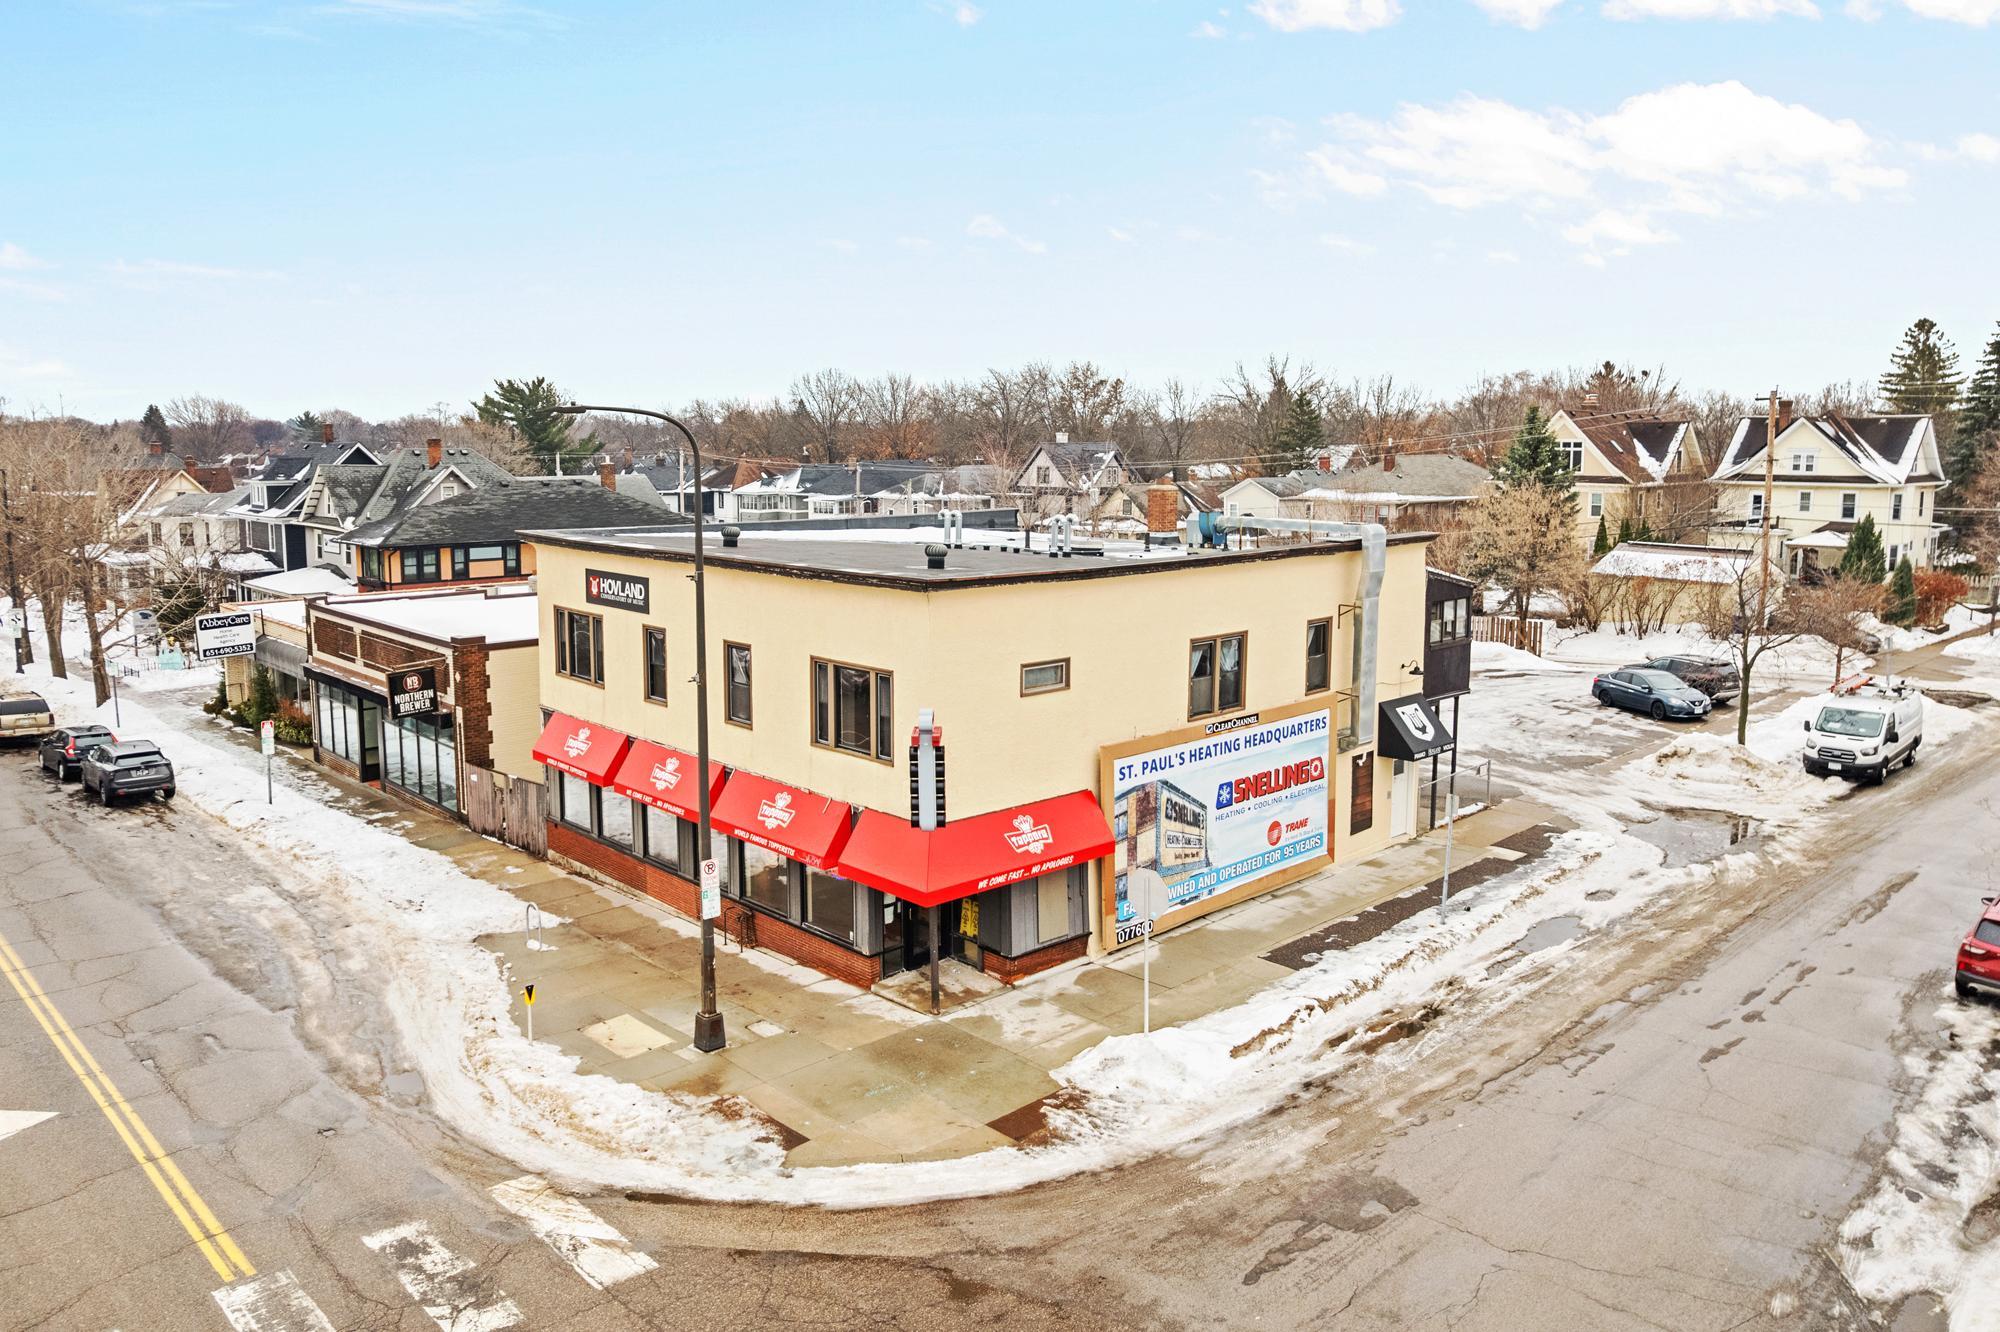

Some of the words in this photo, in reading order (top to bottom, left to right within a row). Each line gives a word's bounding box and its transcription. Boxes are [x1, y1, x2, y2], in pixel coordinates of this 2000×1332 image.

[600, 578, 645, 600] HOVLAND
[201, 615, 250, 629] AbbeyCare
[205, 644, 252, 657] 651-690-5352
[394, 688, 434, 705] NORTHERN
[399, 698, 431, 713] BREWER
[1118, 764, 1138, 781] ST.
[1141, 751, 1186, 776] PAUL'S
[1189, 737, 1241, 763] HEATING
[1244, 716, 1327, 749] HEADQUARTERS
[1234, 759, 1310, 804] SNELLING
[1215, 807, 1246, 822] HEATING
[1253, 795, 1283, 810] COOLING
[1290, 783, 1325, 799] ELECTRICAL
[1285, 817, 1309, 834] TRANE
[734, 828, 750, 840] WORLD
[749, 833, 768, 846] FAMOUS
[977, 878, 989, 890] WE
[989, 873, 1008, 886] COME
[1007, 868, 1024, 881] FAST
[1030, 864, 1041, 875] NO
[1040, 855, 1075, 872] APOLOGIES
[1168, 882, 1195, 900] WNED
[1197, 872, 1217, 890] AND
[1219, 857, 1263, 881] OPERATED
[1264, 849, 1281, 865] FOR
[1283, 844, 1294, 858] 95
[1295, 835, 1321, 854] YEARS
